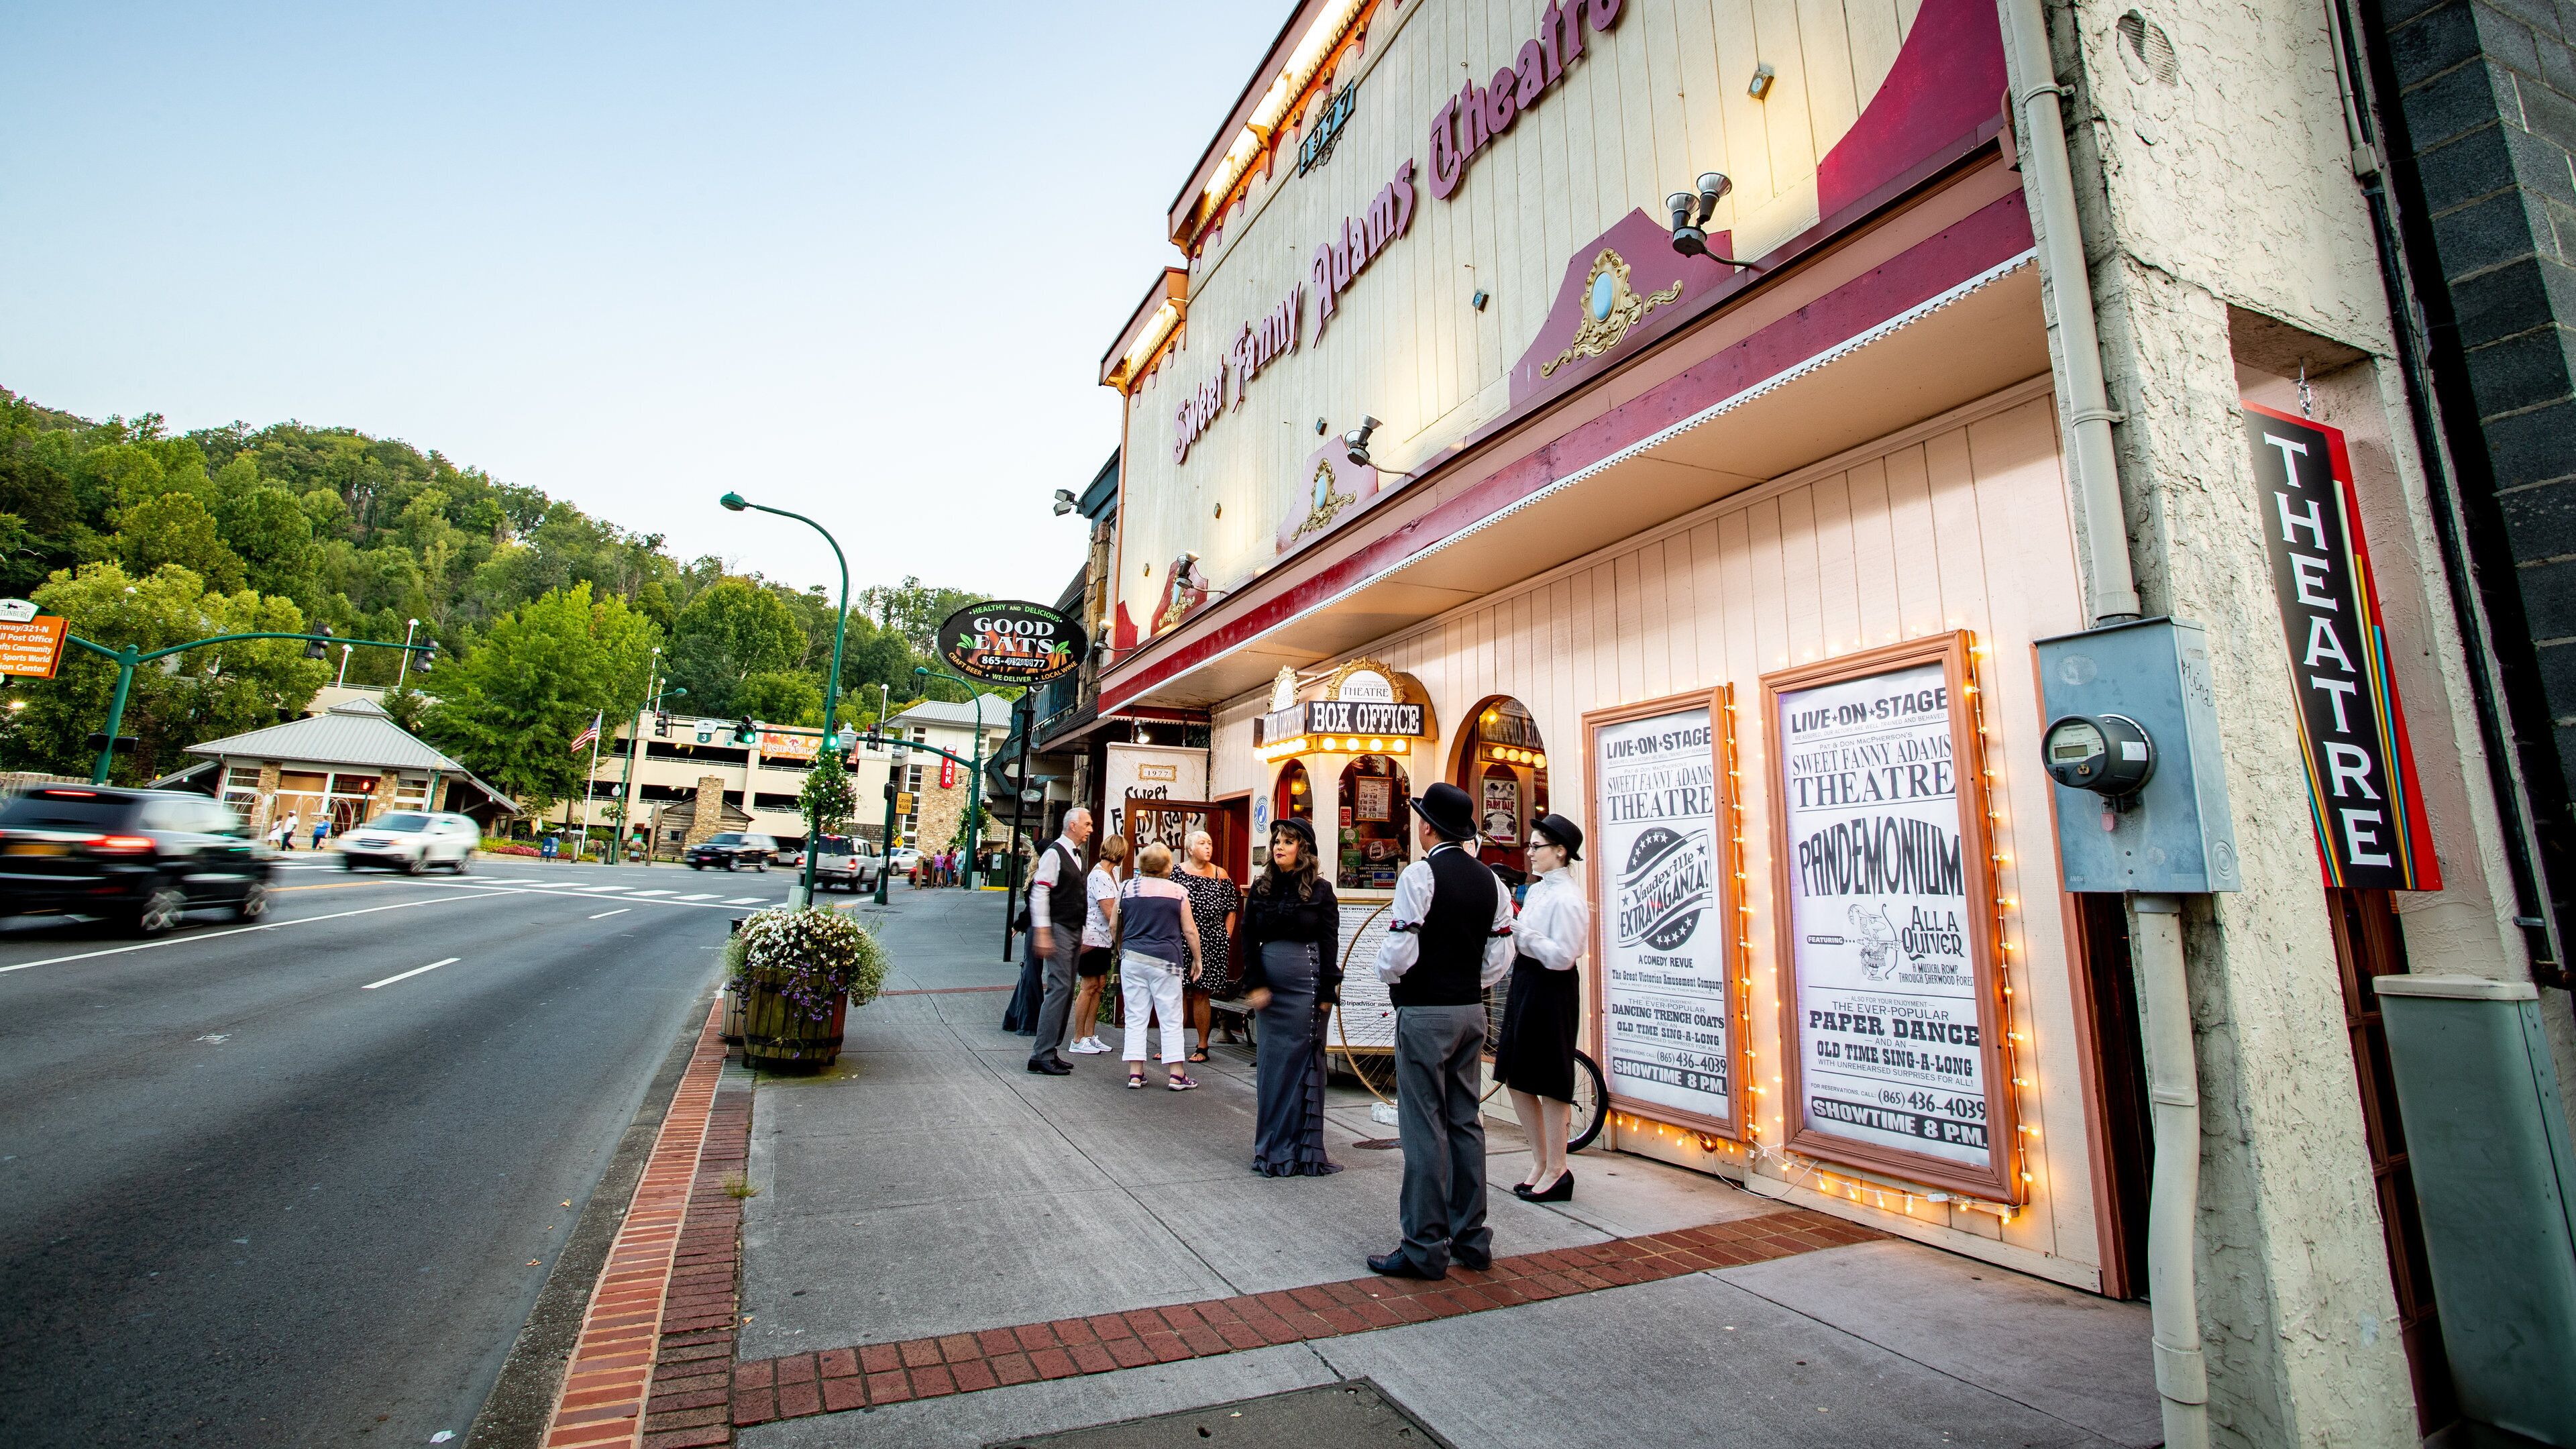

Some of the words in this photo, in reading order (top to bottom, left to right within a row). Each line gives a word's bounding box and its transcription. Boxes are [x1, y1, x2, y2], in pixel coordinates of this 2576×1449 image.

[1302, 89, 1352, 167] 1977
[1173, 354, 1224, 464] Sweet
[1230, 281, 1301, 413] Fanny
[1313, 158, 1414, 348] Adams
[973, 604, 1006, 614] HEALTHY
[1025, 606, 1060, 623] DELICIOUS
[7, 633, 26, 641] Post
[28, 635, 53, 643] Office
[973, 618, 1054, 636] GOOD
[12, 644, 52, 654] Community
[973, 635, 1053, 653] EATS
[2263, 431, 2392, 867] THEATRE
[3, 653, 27, 661] Sports
[28, 655, 51, 663] World
[16, 664, 47, 672] Center
[949, 652, 965, 667] CRAFT
[966, 665, 982, 676] BEER
[1041, 671, 1061, 680] LOCAL
[1061, 661, 1077, 672] WINE
[1342, 686, 1389, 697] THEATRE
[1313, 702, 1351, 732] BOX
[1356, 704, 1419, 734] OFFICE
[1792, 708, 1830, 733] LIVE
[1838, 702, 1868, 726] ON
[1875, 687, 1947, 720] STAGE
[1265, 713, 1278, 743] BOX
[1880, 719, 1902, 727] TRAINED
[1607, 740, 1634, 759] LIVE
[1638, 736, 1658, 754] ON
[1662, 727, 1711, 751] STAGE
[1793, 750, 1838, 776] SWEET
[1841, 743, 1890, 769] FANNY
[1897, 734, 1951, 763] ADAMS
[1608, 774, 1638, 794] SWEET
[1640, 770, 1673, 791] FANNY
[1675, 764, 1712, 787] ADAMS
[1793, 760, 1956, 808] THEATRE
[1608, 786, 1713, 821] THEATRE
[1799, 816, 1965, 900] PANDEMONIUM
[1631, 852, 1694, 905] Vaudeville
[1620, 859, 1709, 938] EXTRAVAGANZA!
[1912, 906, 1943, 932] ALL
[1947, 911, 1960, 932] A
[1902, 927, 1966, 961] QUIVER
[1639, 955, 1643, 964] A
[1644, 955, 1667, 966] COMEDY
[1670, 957, 1693, 968] REVUE
[1913, 963, 1917, 972] A
[1918, 963, 1940, 974] MUSICAL
[1941, 964, 1958, 974] ROMP
[1612, 969, 1621, 979] The
[1623, 971, 1638, 981] Great
[1639, 972, 1662, 983] Victorian
[1664, 974, 1696, 987] Amusement
[1697, 977, 1723, 992] Company
[1898, 972, 1925, 983] THROUGH
[1925, 973, 1955, 985] SHERWOOD
[1612, 1004, 1652, 1018] DANCING
[1654, 1009, 1692, 1024] TRENCH
[1694, 1014, 1725, 1029] COATS
[1646, 1000, 1705, 1013] EVER-POPULAR
[1832, 1002, 1854, 1012] THE
[1858, 1003, 1949, 1021] EVER-POPULAR
[1617, 1021, 1633, 1032] OLD
[1636, 1024, 1658, 1036] TIME
[1662, 1028, 1719, 1046] SING-A-LONG
[1631, 1033, 1666, 1043] UNREHEARSED
[1668, 1040, 1695, 1048] SURPRISES
[1809, 1010, 1885, 1036] PAPER
[1892, 1018, 1980, 1047] DANCE
[1875, 1038, 1892, 1046] AND
[1657, 1051, 1674, 1066] (865)
[1676, 1052, 1727, 1074] 436-4039
[1817, 1040, 1840, 1058] OLD
[1845, 1043, 1879, 1064] TIME
[1882, 1048, 1973, 1077] SING-A-LONG
[1614, 1060, 1682, 1085] SHOWTIME
[1687, 1073, 1697, 1088] 8
[1701, 1075, 1726, 1094] P.M.
[1818, 1059, 1835, 1067] WITH
[1837, 1061, 1891, 1075] UNREHEARSED
[1893, 1069, 1935, 1081] SURPRISES
[1938, 1075, 1953, 1083] FOR
[1955, 1078, 1974, 1087] ALL!
[1821, 1084, 1860, 1095] RESERVATIONS,
[1878, 1088, 1906, 1108] (865)
[1907, 1091, 1986, 1121] 436-4039
[1813, 1099, 1916, 1134] SHOWTIME
[1924, 1119, 1939, 1138] 8
[1943, 1122, 1988, 1147] P.M.
